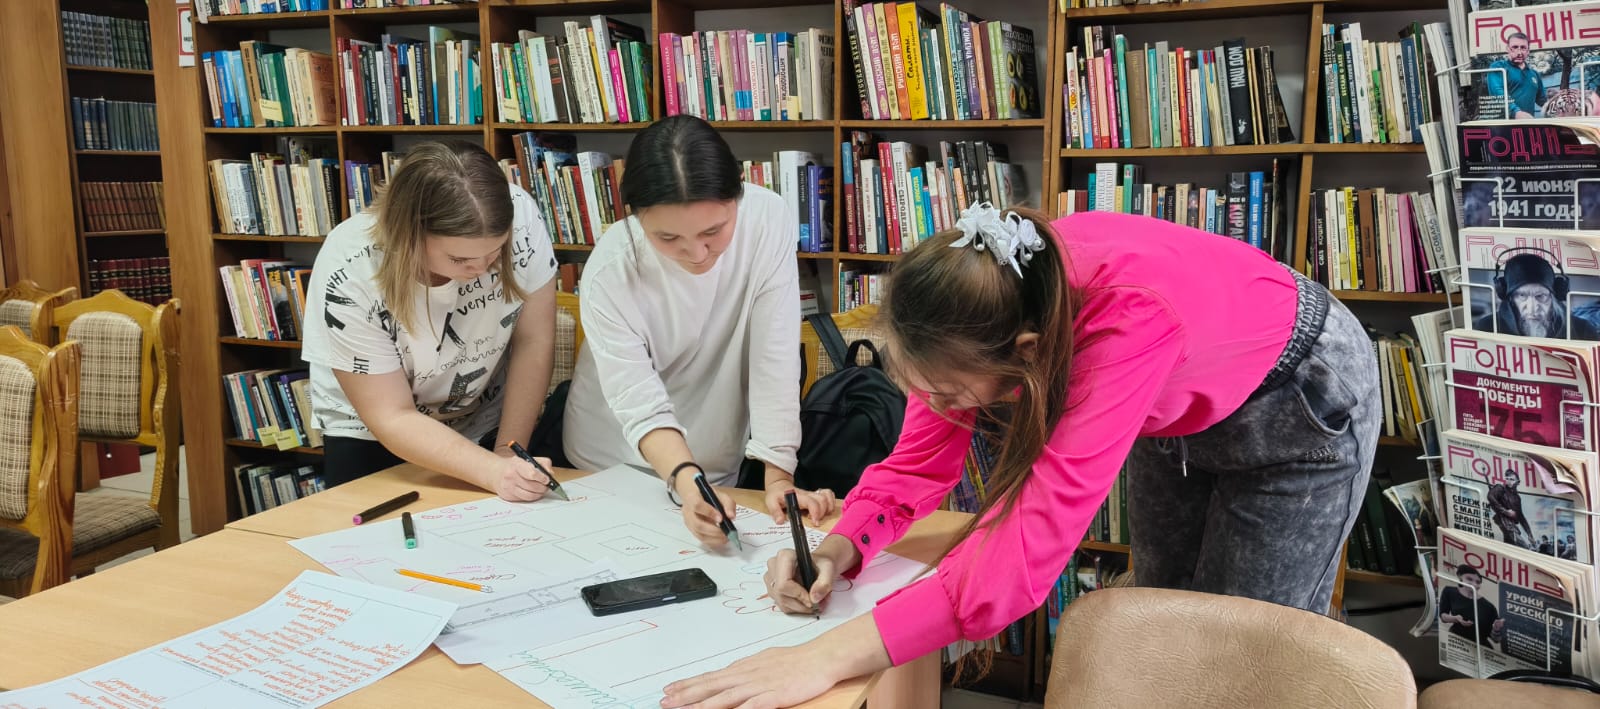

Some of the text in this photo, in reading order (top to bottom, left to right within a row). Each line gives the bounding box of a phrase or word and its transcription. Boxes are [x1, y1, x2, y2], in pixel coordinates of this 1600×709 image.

[1228, 46, 1246, 88] НАШ ДОМ
[1493, 177, 1576, 193] 22 июня
[1488, 201, 1582, 220] 1941 года
[1476, 377, 1540, 395] ДОКУМЕНТЫ
[1479, 388, 1542, 409] ПОБЕДЫ
[1448, 445, 1546, 489] РОДИН
[1505, 591, 1544, 608] УРОКИ
